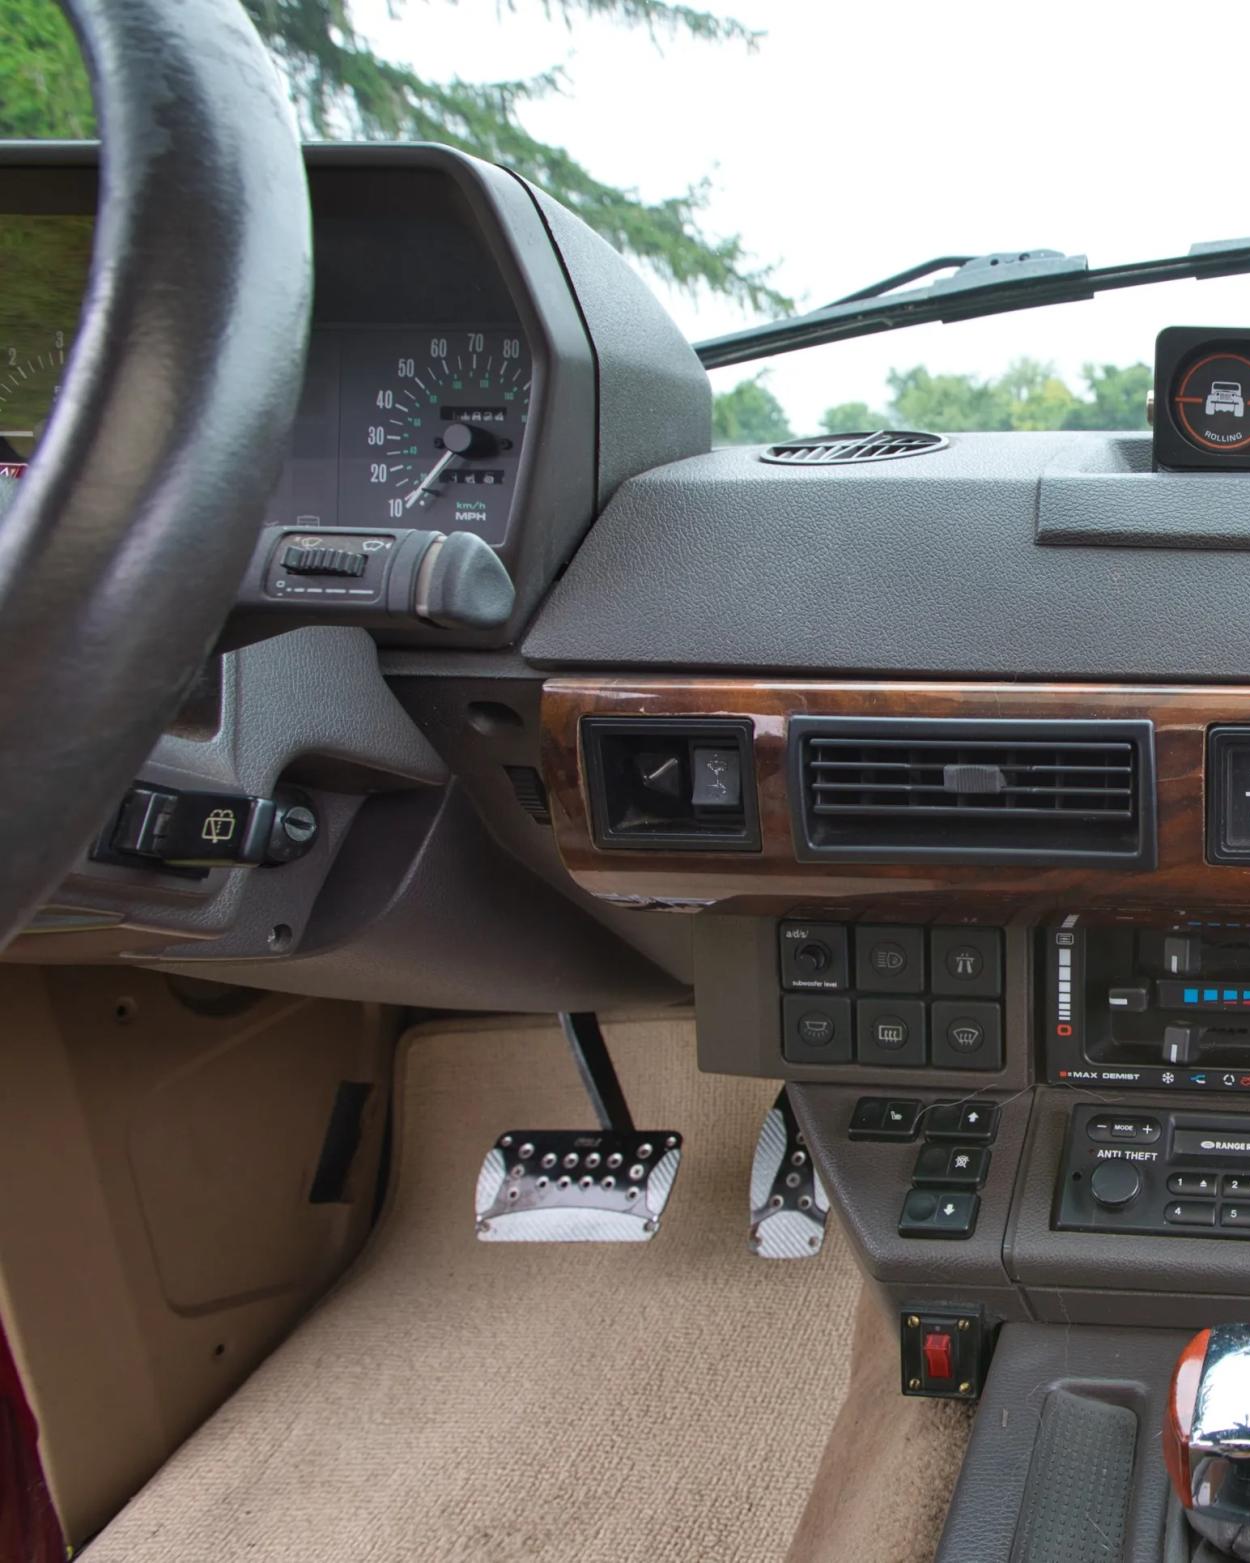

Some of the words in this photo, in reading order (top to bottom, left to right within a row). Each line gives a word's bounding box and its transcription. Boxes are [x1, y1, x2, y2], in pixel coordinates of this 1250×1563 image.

[56, 331, 63, 348] 3
[430, 339, 447, 357] 60
[468, 333, 484, 352] 70
[9, 348, 17, 365] 2
[503, 339, 519, 358] 80
[398, 359, 414, 377] 50
[376, 390, 392, 408] 40
[368, 426, 384, 445] 30
[1204, 430, 1243, 442] ROLLING
[371, 464, 386, 482] 20
[389, 500, 402, 517] 10
[455, 512, 486, 520] MPH
[1216, 1142, 1245, 1150] RANGE
[1097, 1150, 1121, 1158] ANTI
[1125, 1151, 1158, 1161] THEFT
[1175, 1207, 1181, 1215] 4
[1231, 1210, 1237, 1218] 5
